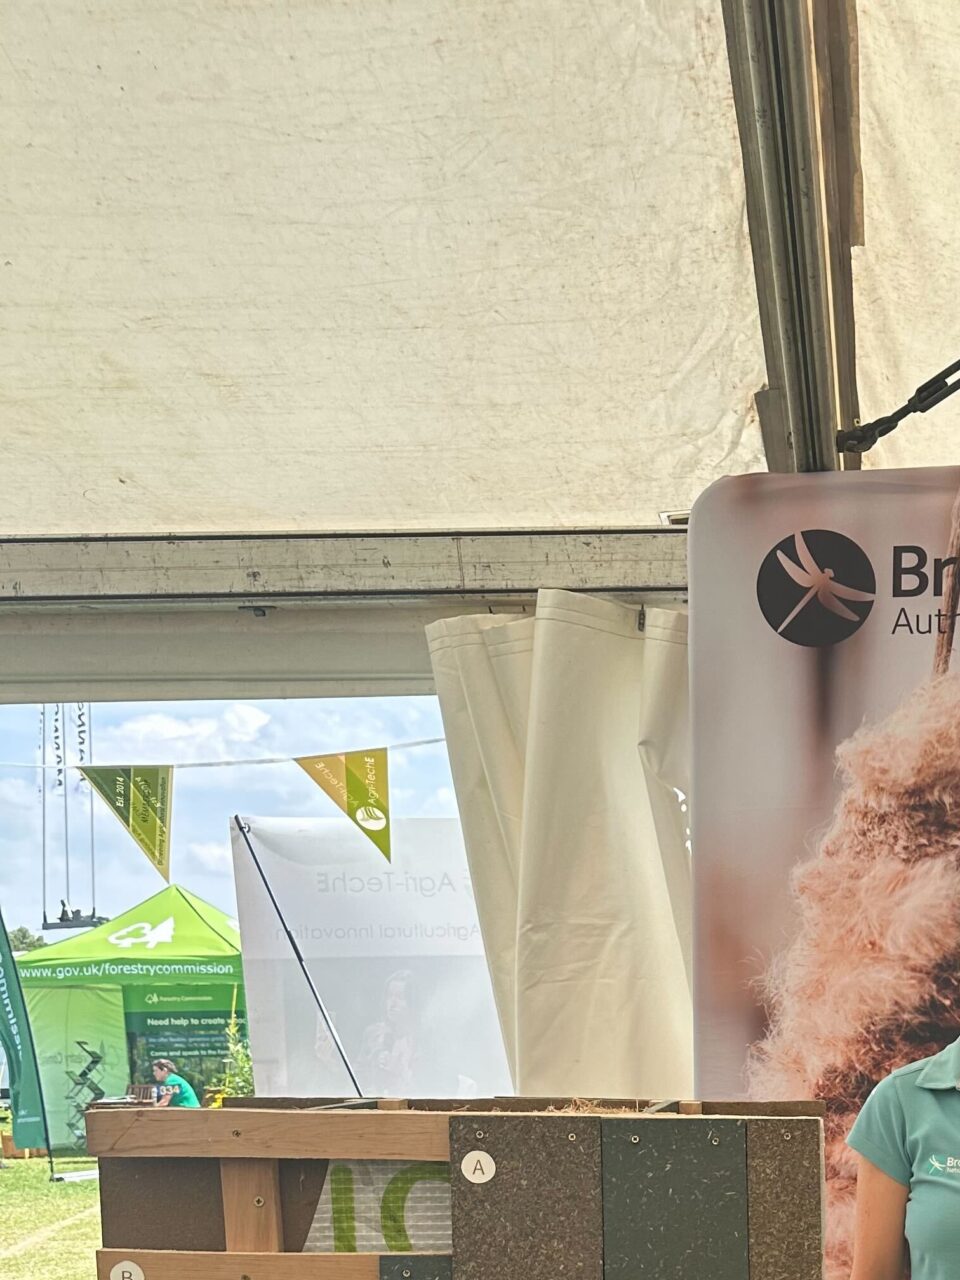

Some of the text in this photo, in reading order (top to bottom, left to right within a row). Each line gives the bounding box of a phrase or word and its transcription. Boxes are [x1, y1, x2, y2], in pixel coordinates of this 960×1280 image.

[364, 756, 379, 805] Agri-TechE
[19, 962, 234, 979] www.gov.uk/forestrycommission
[147, 1018, 169, 1026] Need
[171, 1017, 189, 1027] help
[191, 1017, 200, 1025] to
[201, 1017, 225, 1025] create
[472, 1159, 485, 1176] A
